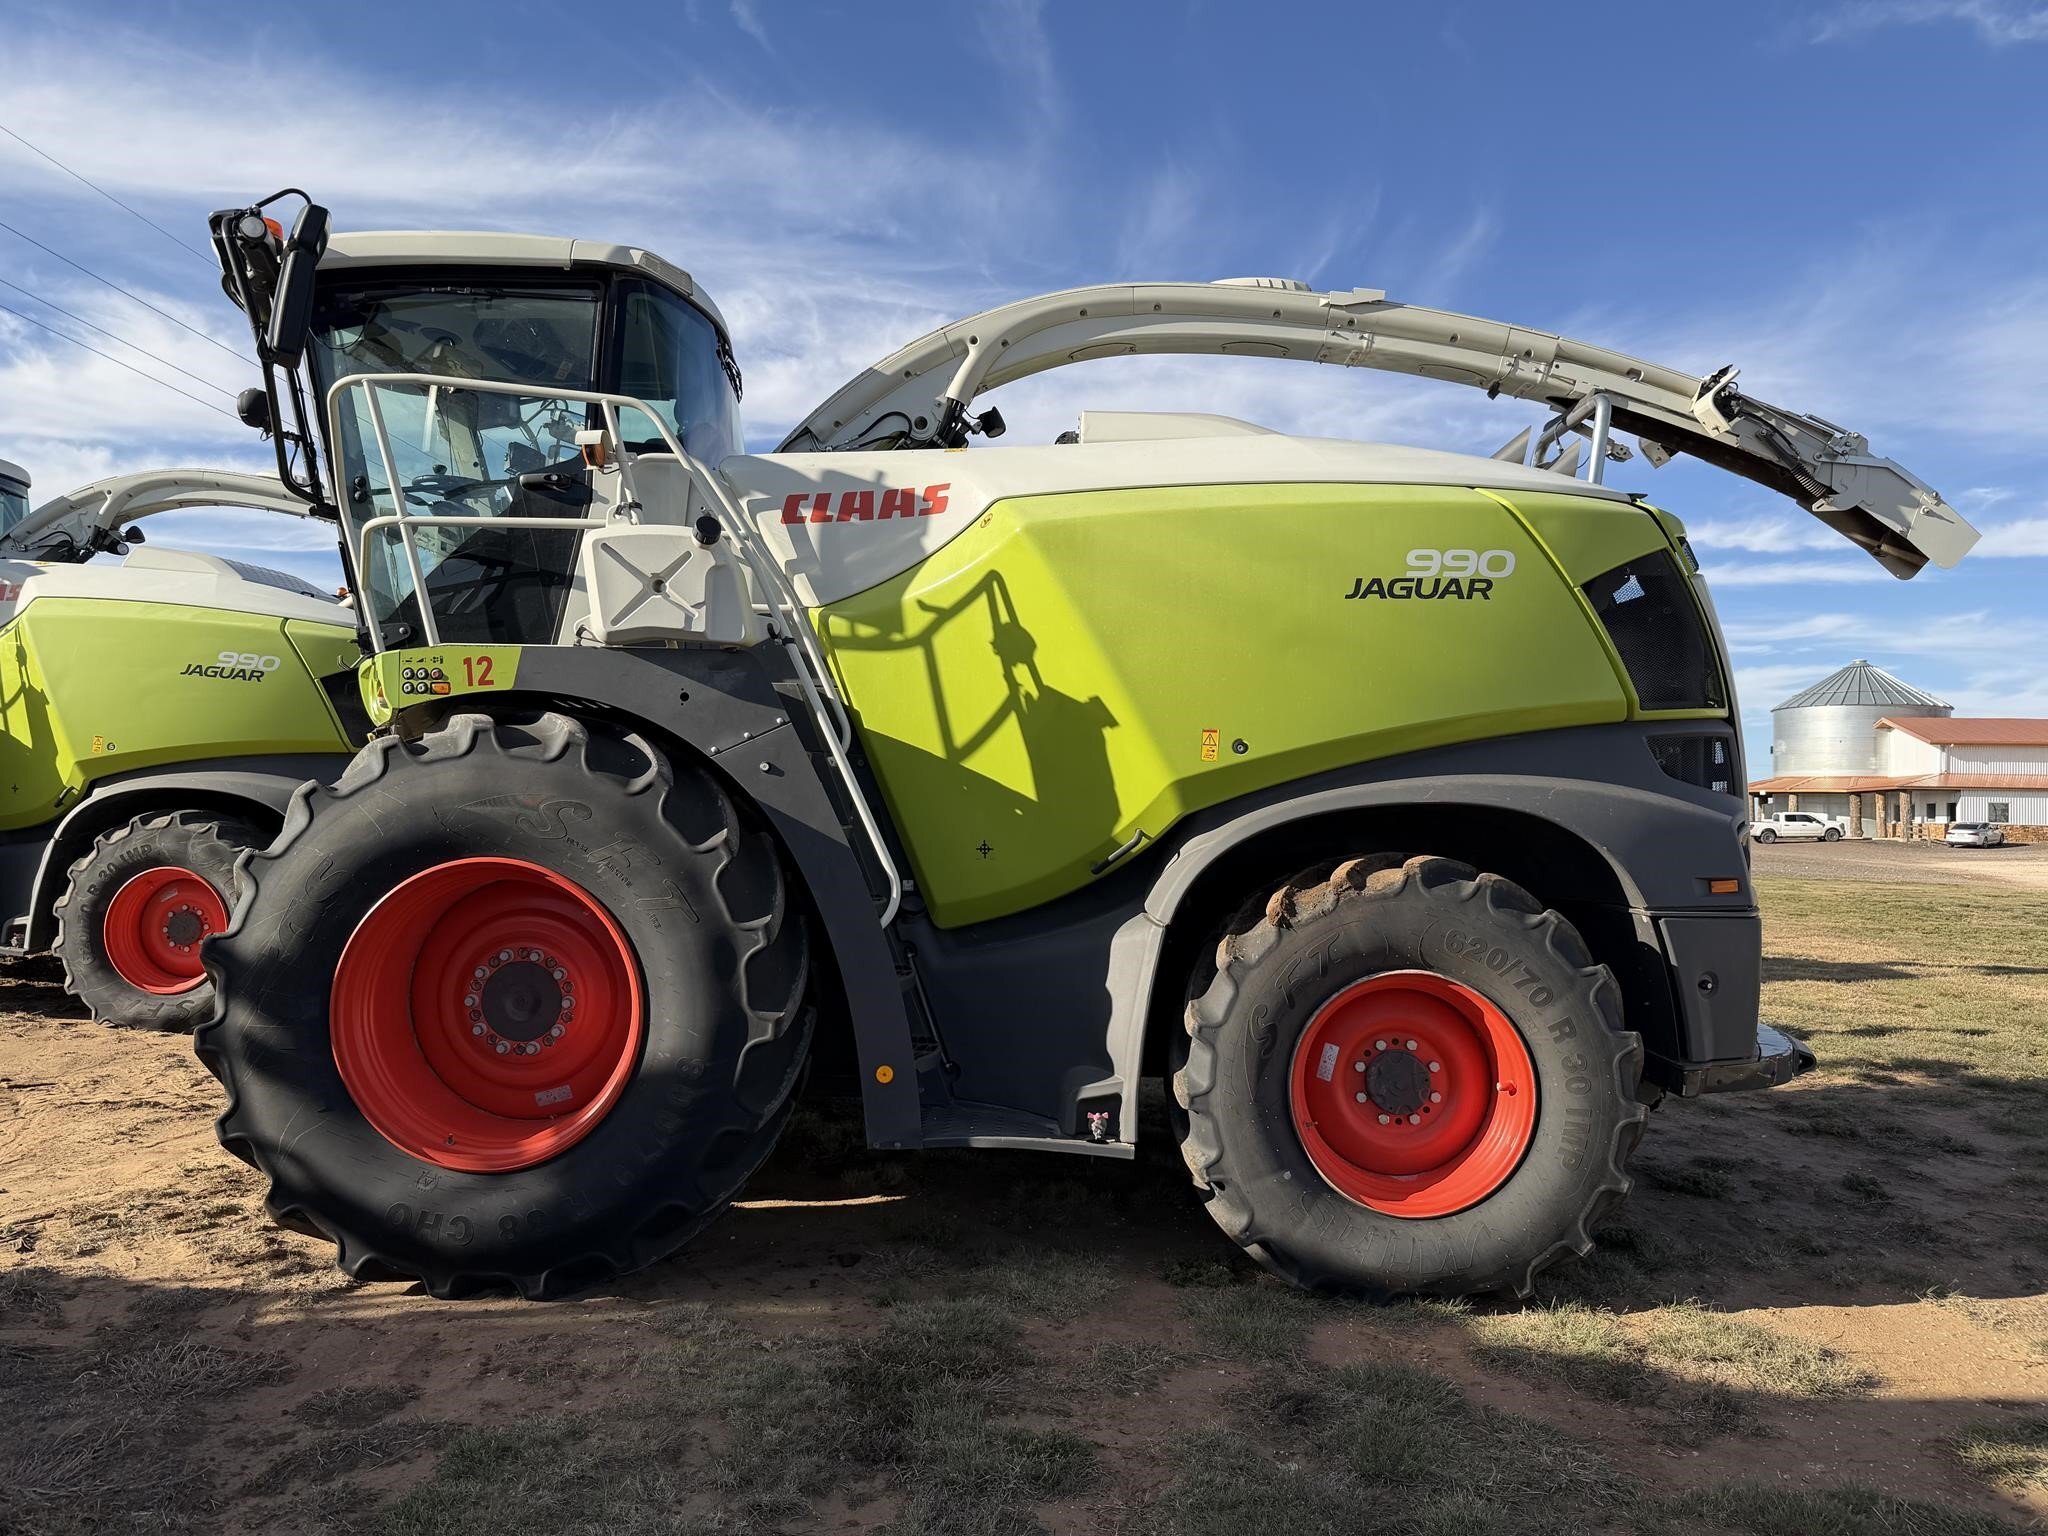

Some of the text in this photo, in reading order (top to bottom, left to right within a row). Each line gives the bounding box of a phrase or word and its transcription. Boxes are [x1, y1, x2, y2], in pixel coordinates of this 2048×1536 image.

[781, 483, 951, 525] CLAAS
[1406, 549, 1516, 578] 990
[1344, 577, 1494, 600] JAGUAR
[180, 663, 265, 682] JAGUAR
[217, 651, 281, 672] 990
[463, 656, 495, 687] 12
[1444, 927, 1554, 1009] 620/70
[1546, 1015, 1578, 1045] R
[1560, 1052, 1592, 1097] 30
[1557, 1107, 1593, 1171] IMP
[384, 1200, 477, 1249] CHO
